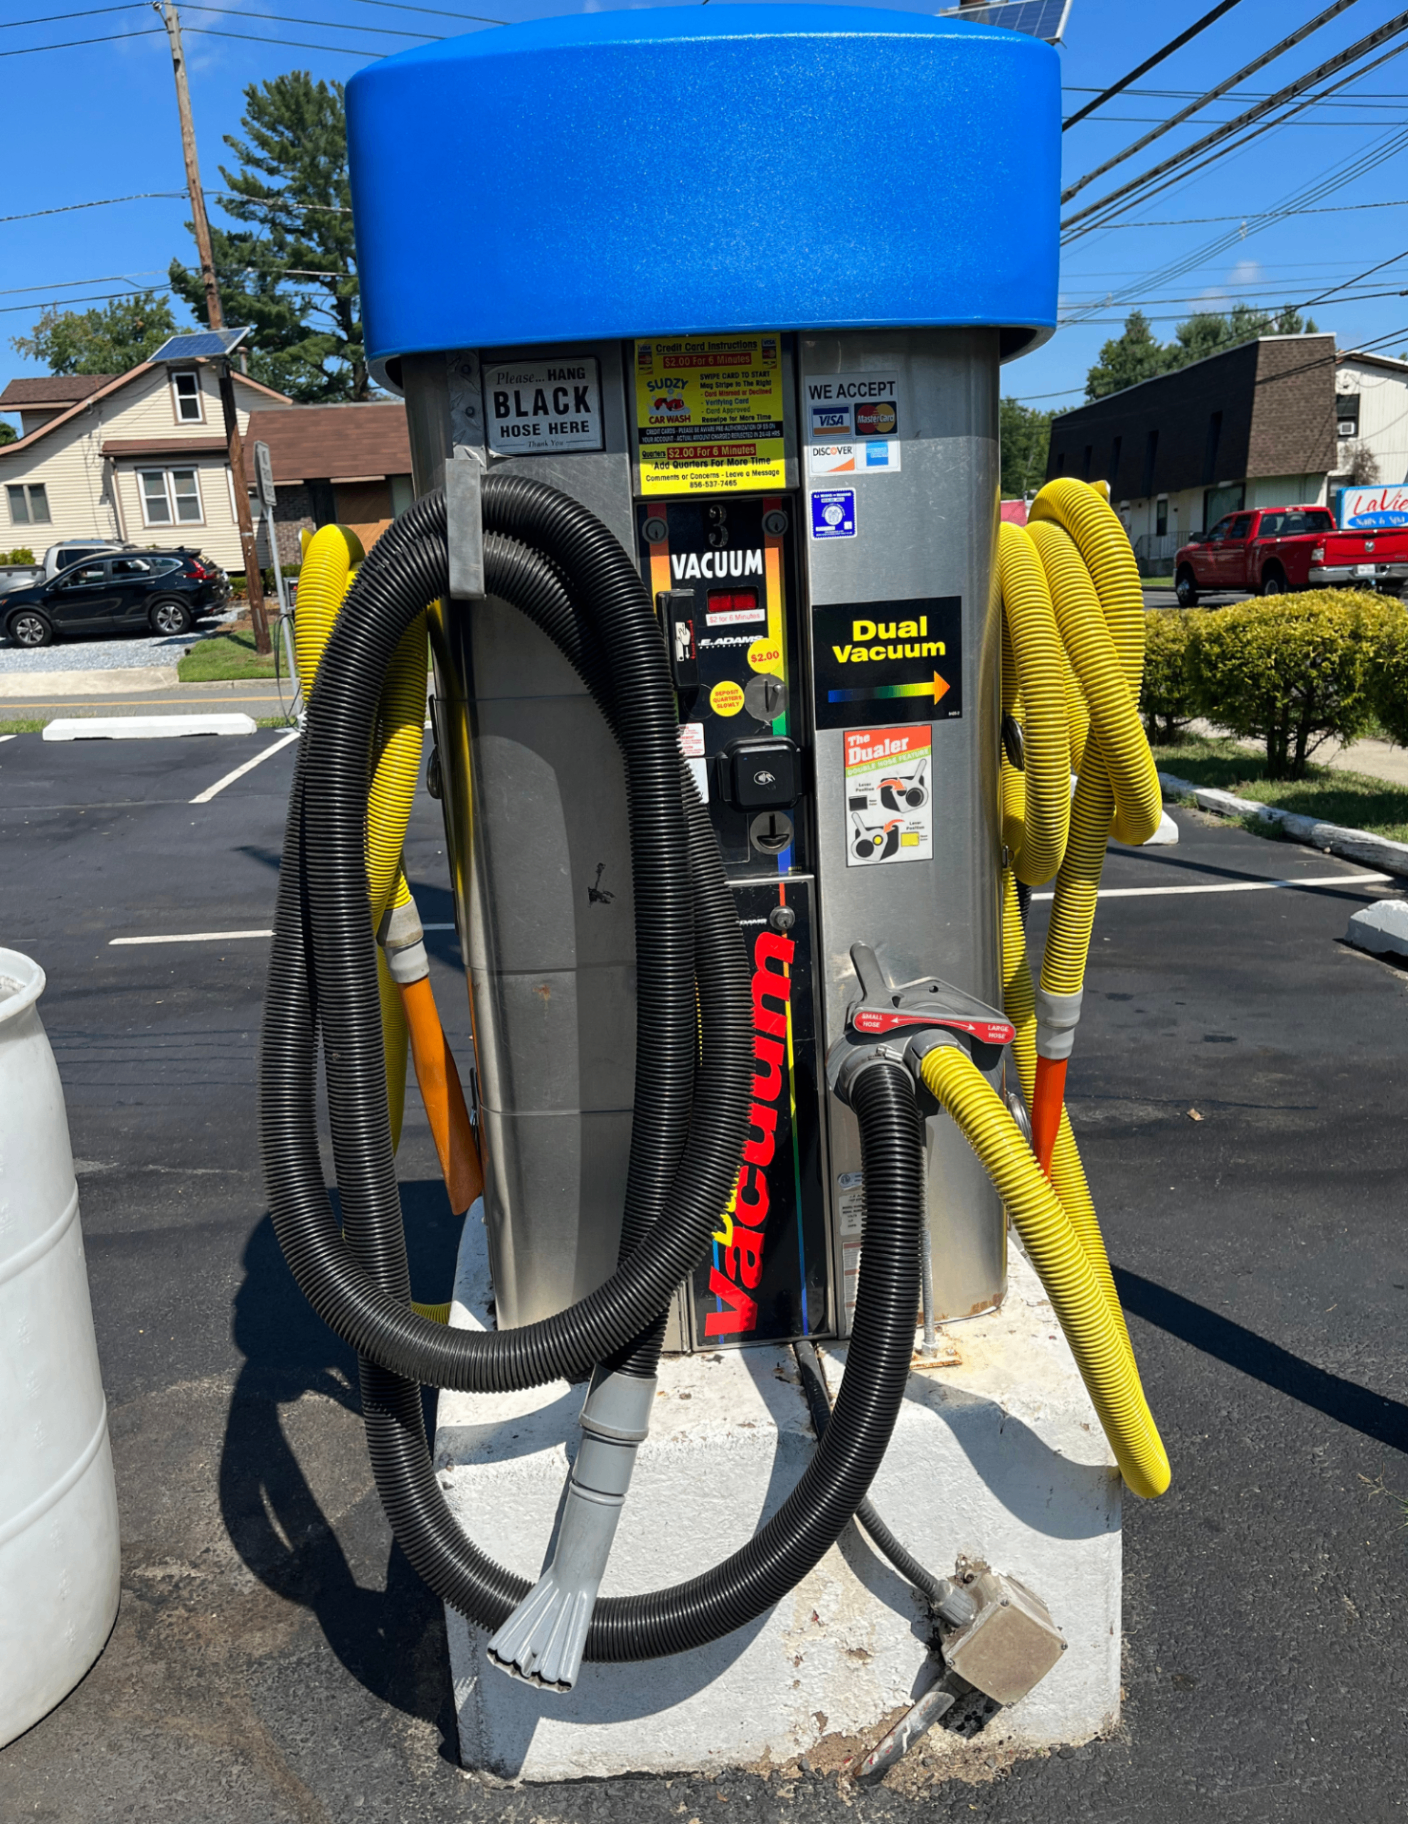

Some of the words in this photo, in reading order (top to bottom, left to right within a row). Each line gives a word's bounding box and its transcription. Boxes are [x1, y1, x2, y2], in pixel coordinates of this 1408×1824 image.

[656, 343, 682, 352] Credit
[685, 342, 705, 351] Card
[708, 340, 758, 350] Instructions
[665, 356, 690, 367] $2.00
[692, 356, 706, 365] For
[709, 356, 714, 364] 6
[717, 354, 750, 364] Minutes
[547, 367, 586, 381] HANG
[700, 372, 720, 380] SWIPE
[751, 370, 770, 378] START
[646, 378, 688, 392] SUDZY
[700, 382, 714, 390] Mag
[756, 379, 772, 387] Right
[808, 384, 832, 400] WE
[836, 381, 896, 398] ACCEPT
[493, 386, 592, 419] BLACK
[706, 398, 732, 406] Verifying
[722, 407, 750, 415] Approved
[649, 416, 666, 424] CAR
[666, 415, 691, 424] WASH
[702, 416, 728, 424] Reswipe
[740, 414, 756, 422] More
[819, 415, 844, 426] VISA
[857, 414, 895, 424] MasterCard
[501, 424, 541, 438] HOSE
[548, 420, 590, 434] HERE
[642, 450, 666, 458] Quarters
[668, 449, 694, 458] $2.00
[697, 448, 710, 456] For
[712, 447, 718, 455] 6
[722, 445, 755, 455] Minutes
[812, 446, 852, 456] DISCOVER
[654, 462, 670, 470] Add
[672, 460, 708, 469] Quarters
[710, 458, 724, 467] For
[727, 458, 748, 466] More
[751, 456, 771, 465] Time
[646, 474, 680, 482] Comments
[690, 472, 720, 480] Concerns
[752, 469, 780, 478] Message
[708, 504, 728, 547] 3
[672, 549, 763, 580] VACUUM
[710, 616, 717, 624] $2
[852, 616, 928, 642] Dual
[751, 650, 780, 662] $2.00
[832, 641, 946, 663] Vacuum
[713, 695, 742, 703] QUARTERS
[848, 734, 870, 746] The
[848, 737, 909, 765] Dualer
[848, 763, 876, 776] DOUBLE
[880, 757, 897, 767] HOSE
[899, 748, 929, 762] FEATURE
[861, 1014, 883, 1022] SMALL
[988, 1024, 1008, 1033] LARGE
[988, 1032, 1006, 1040] HOSE
[704, 932, 795, 1336] Vacuum
